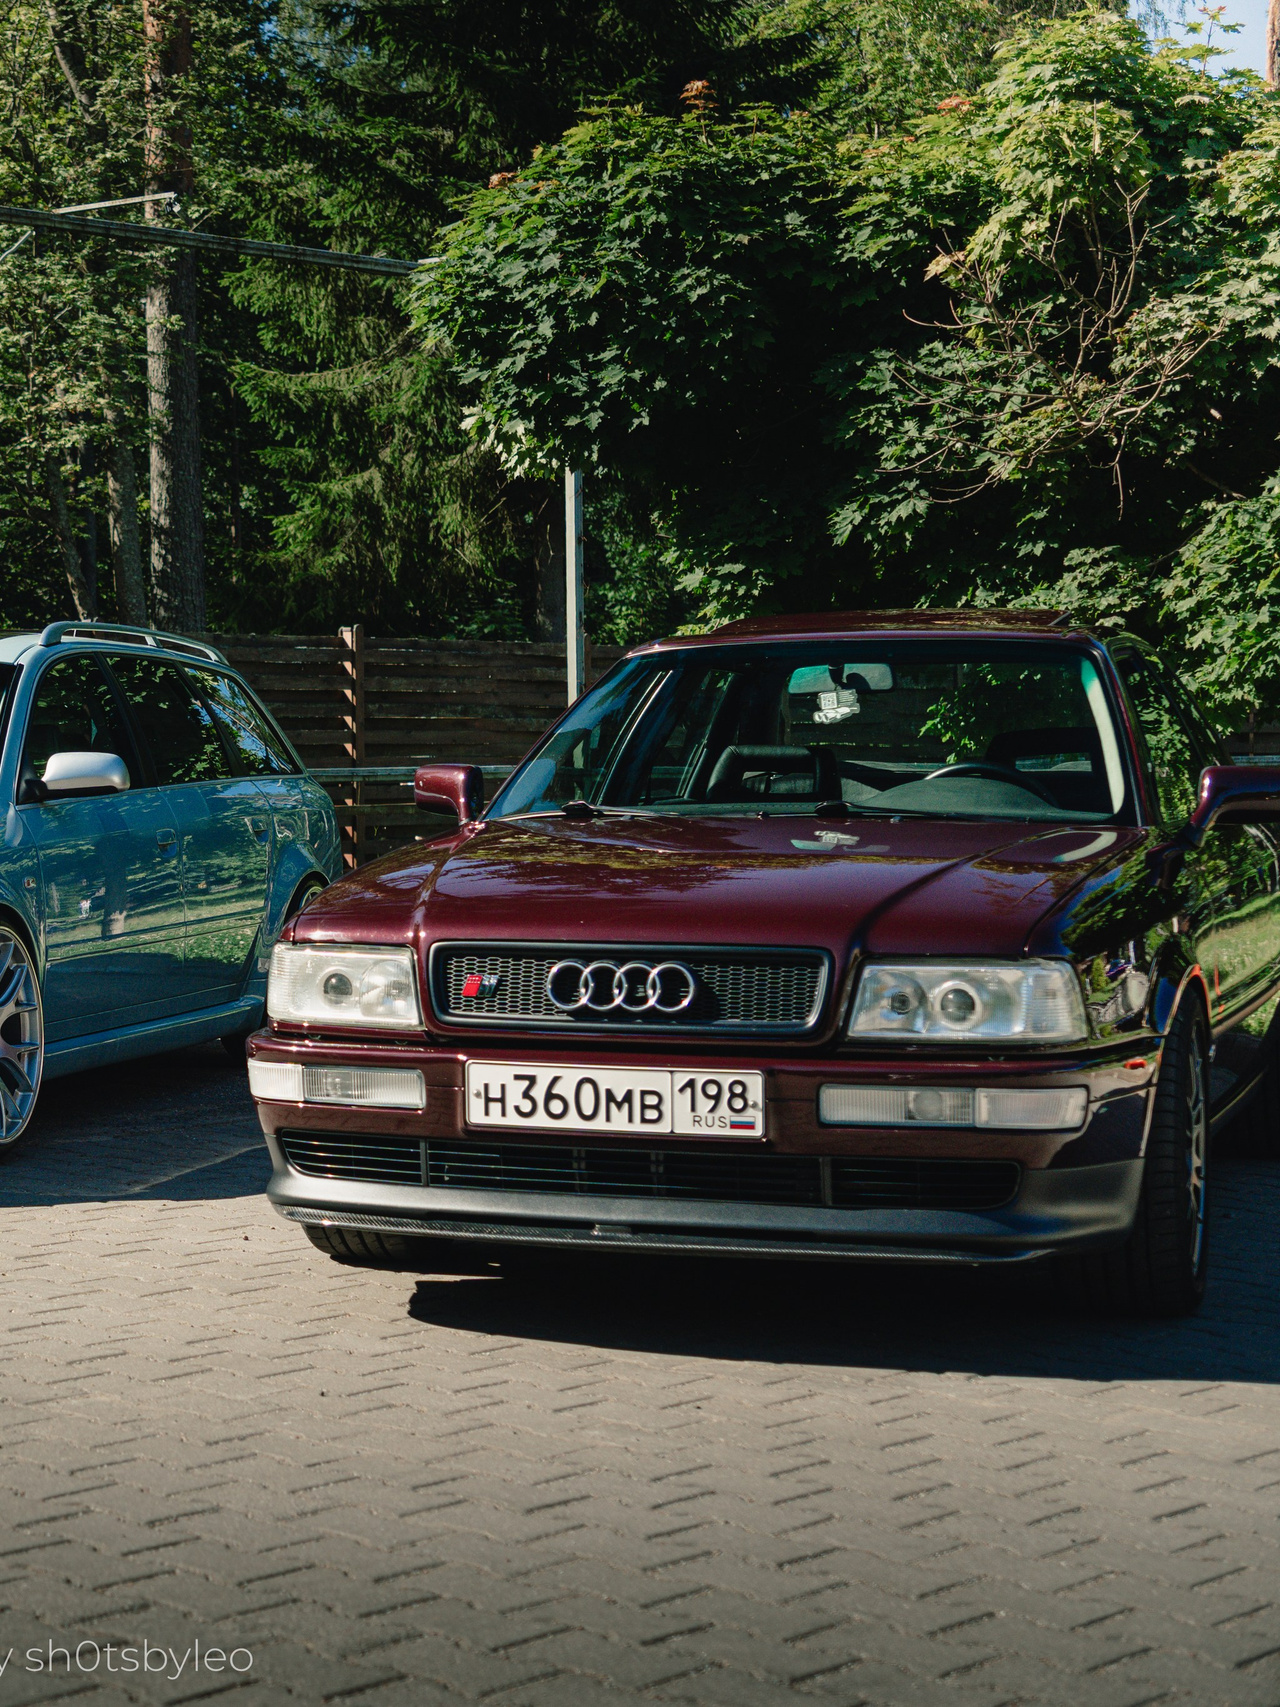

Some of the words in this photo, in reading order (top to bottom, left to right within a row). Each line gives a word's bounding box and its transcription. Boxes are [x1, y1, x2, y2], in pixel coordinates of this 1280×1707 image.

[483, 1074, 664, 1124] Н360МВ
[677, 1078, 749, 1114] 198
[692, 1115, 728, 1128] RUS
